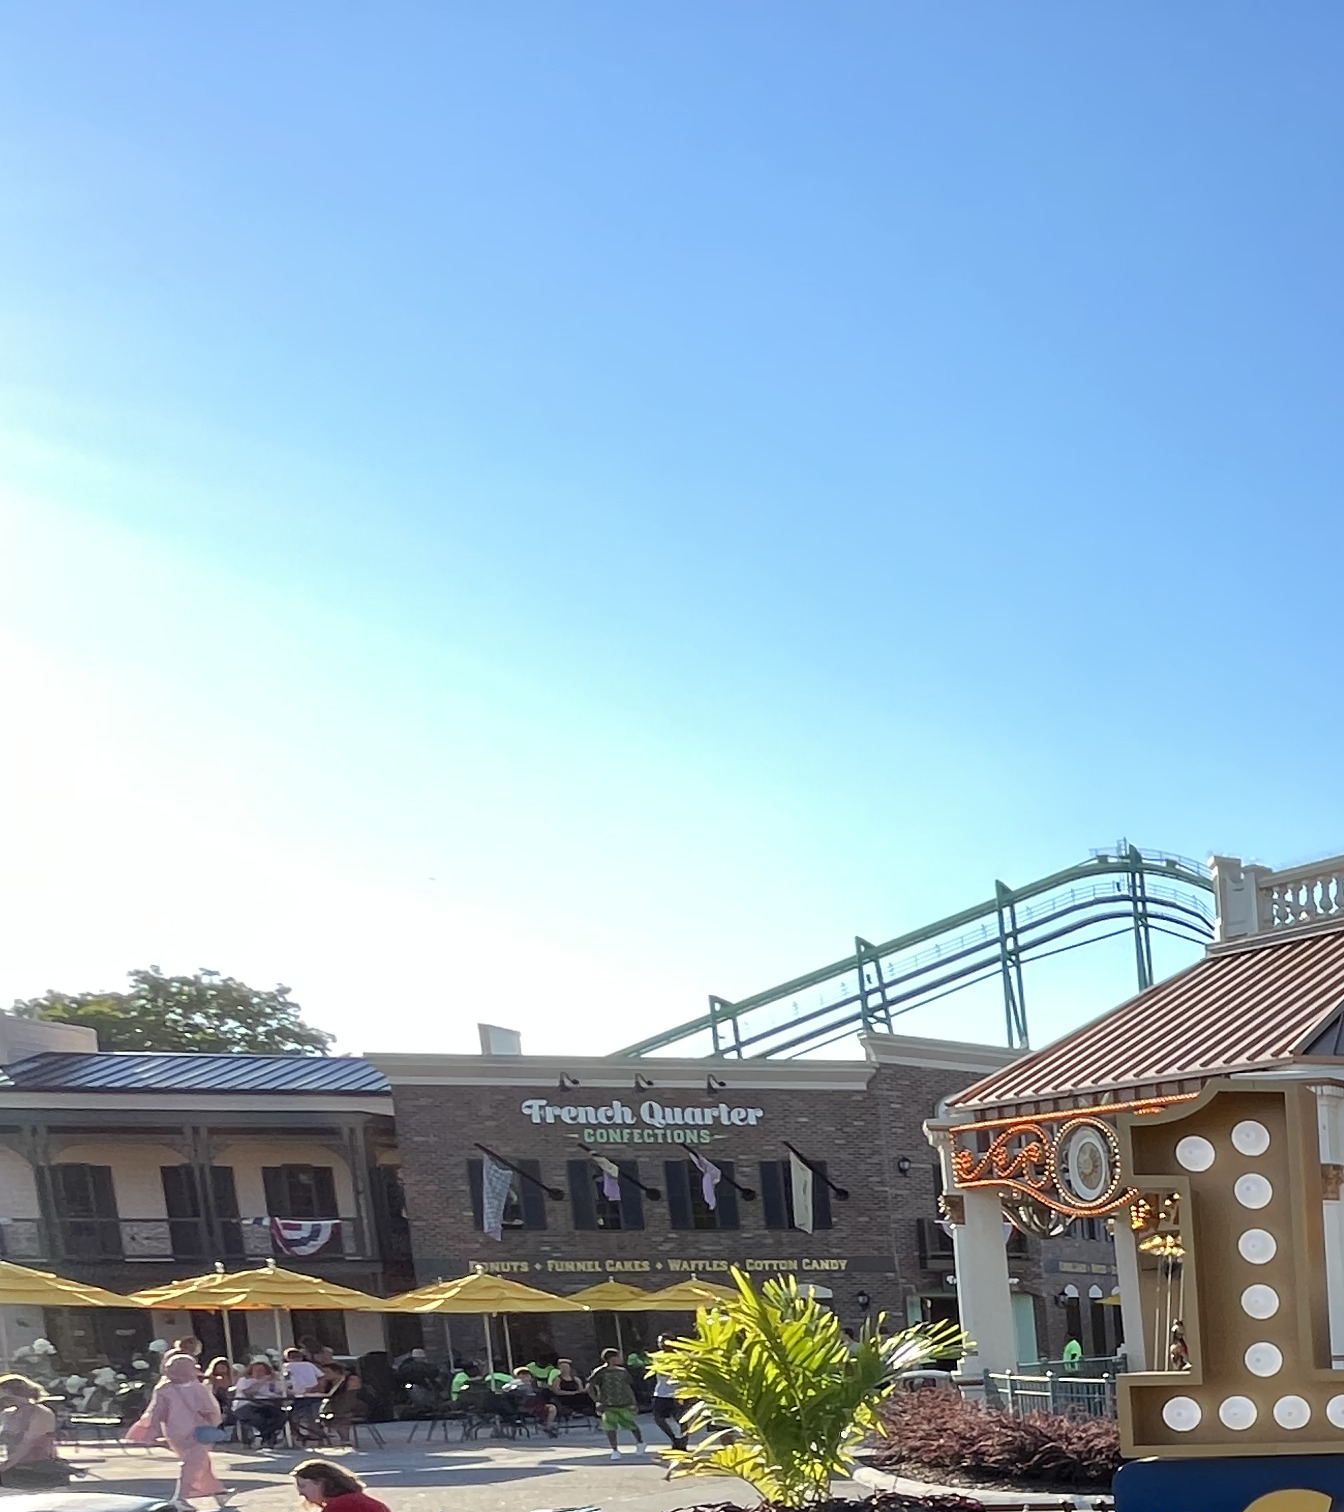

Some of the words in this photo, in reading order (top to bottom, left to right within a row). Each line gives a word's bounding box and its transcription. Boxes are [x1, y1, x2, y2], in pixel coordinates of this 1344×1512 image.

[522, 1099, 636, 1125] French
[640, 1099, 764, 1128] Quarter
[583, 1128, 711, 1144] CONFECTIONS
[468, 1260, 529, 1272] DONUTS
[547, 1260, 602, 1272] FUNNEL
[605, 1259, 650, 1272] CAKES
[667, 1259, 729, 1272] WAFFLES
[745, 1258, 798, 1271] COTTON
[802, 1259, 848, 1272] CANDY
